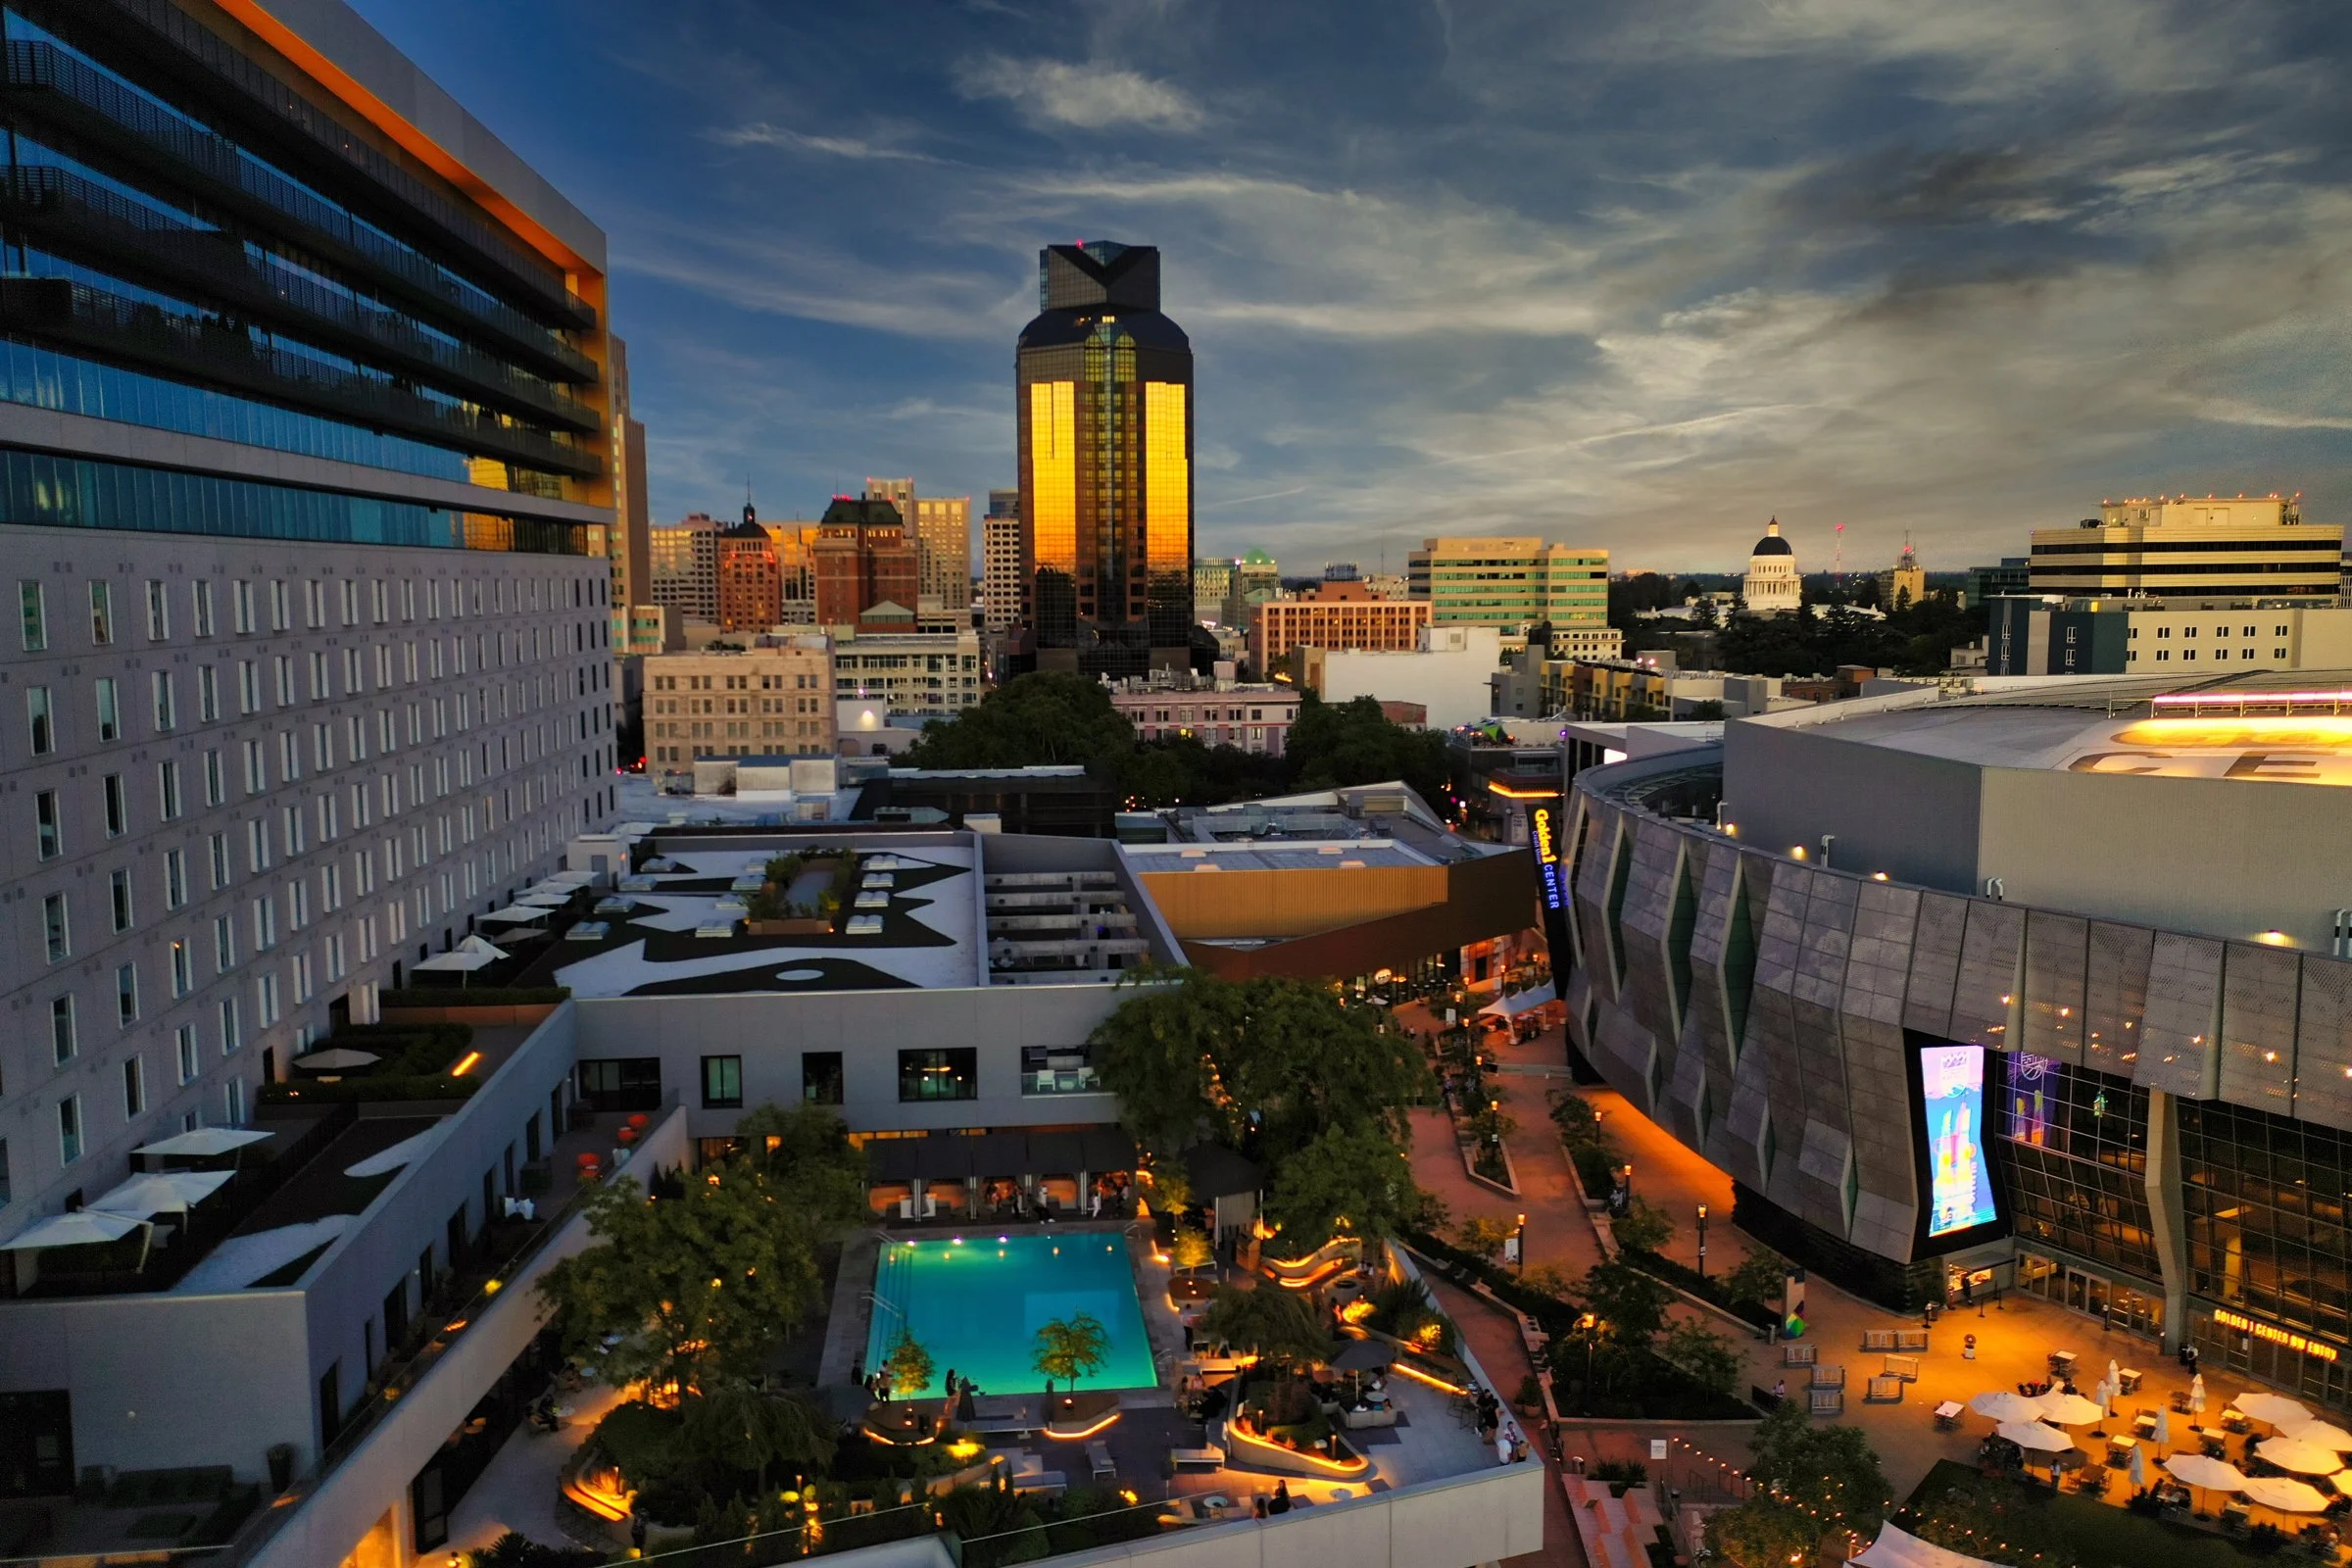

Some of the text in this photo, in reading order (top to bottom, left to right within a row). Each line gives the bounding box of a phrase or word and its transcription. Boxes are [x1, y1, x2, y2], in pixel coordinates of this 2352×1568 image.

[1544, 864, 1559, 909] CENTER
[2215, 1308, 2248, 1331] GOLDEN
[2255, 1323, 2288, 1345] CENTER
[2307, 1341, 2337, 1361] ENTRY
